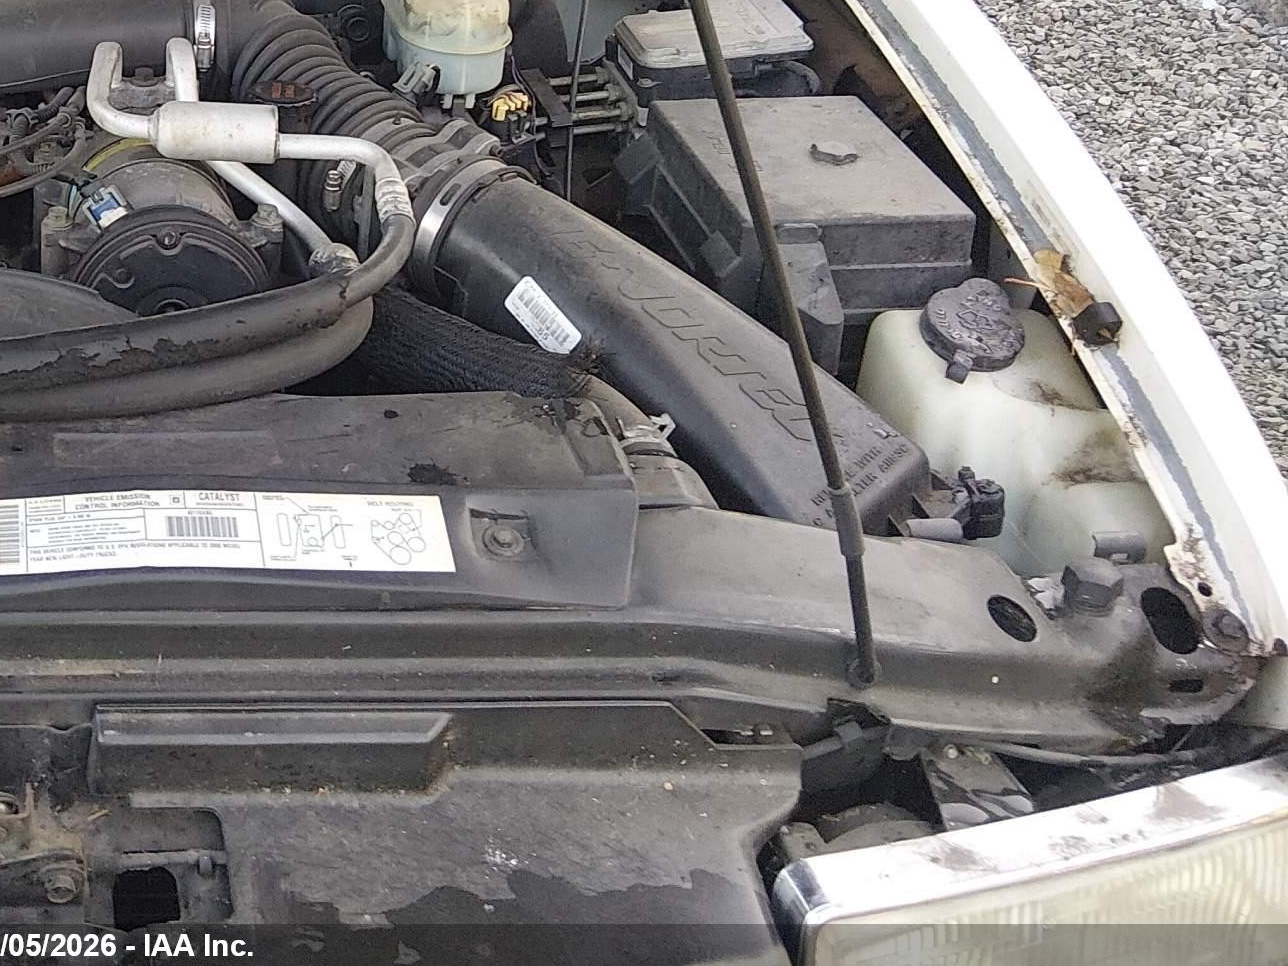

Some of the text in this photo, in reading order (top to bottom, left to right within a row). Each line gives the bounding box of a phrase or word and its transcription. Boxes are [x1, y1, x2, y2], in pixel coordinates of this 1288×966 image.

[116, 493, 151, 501] EMISSION
[198, 492, 241, 502] CATALYST
[75, 500, 160, 511] CONTROL INFORMATION
